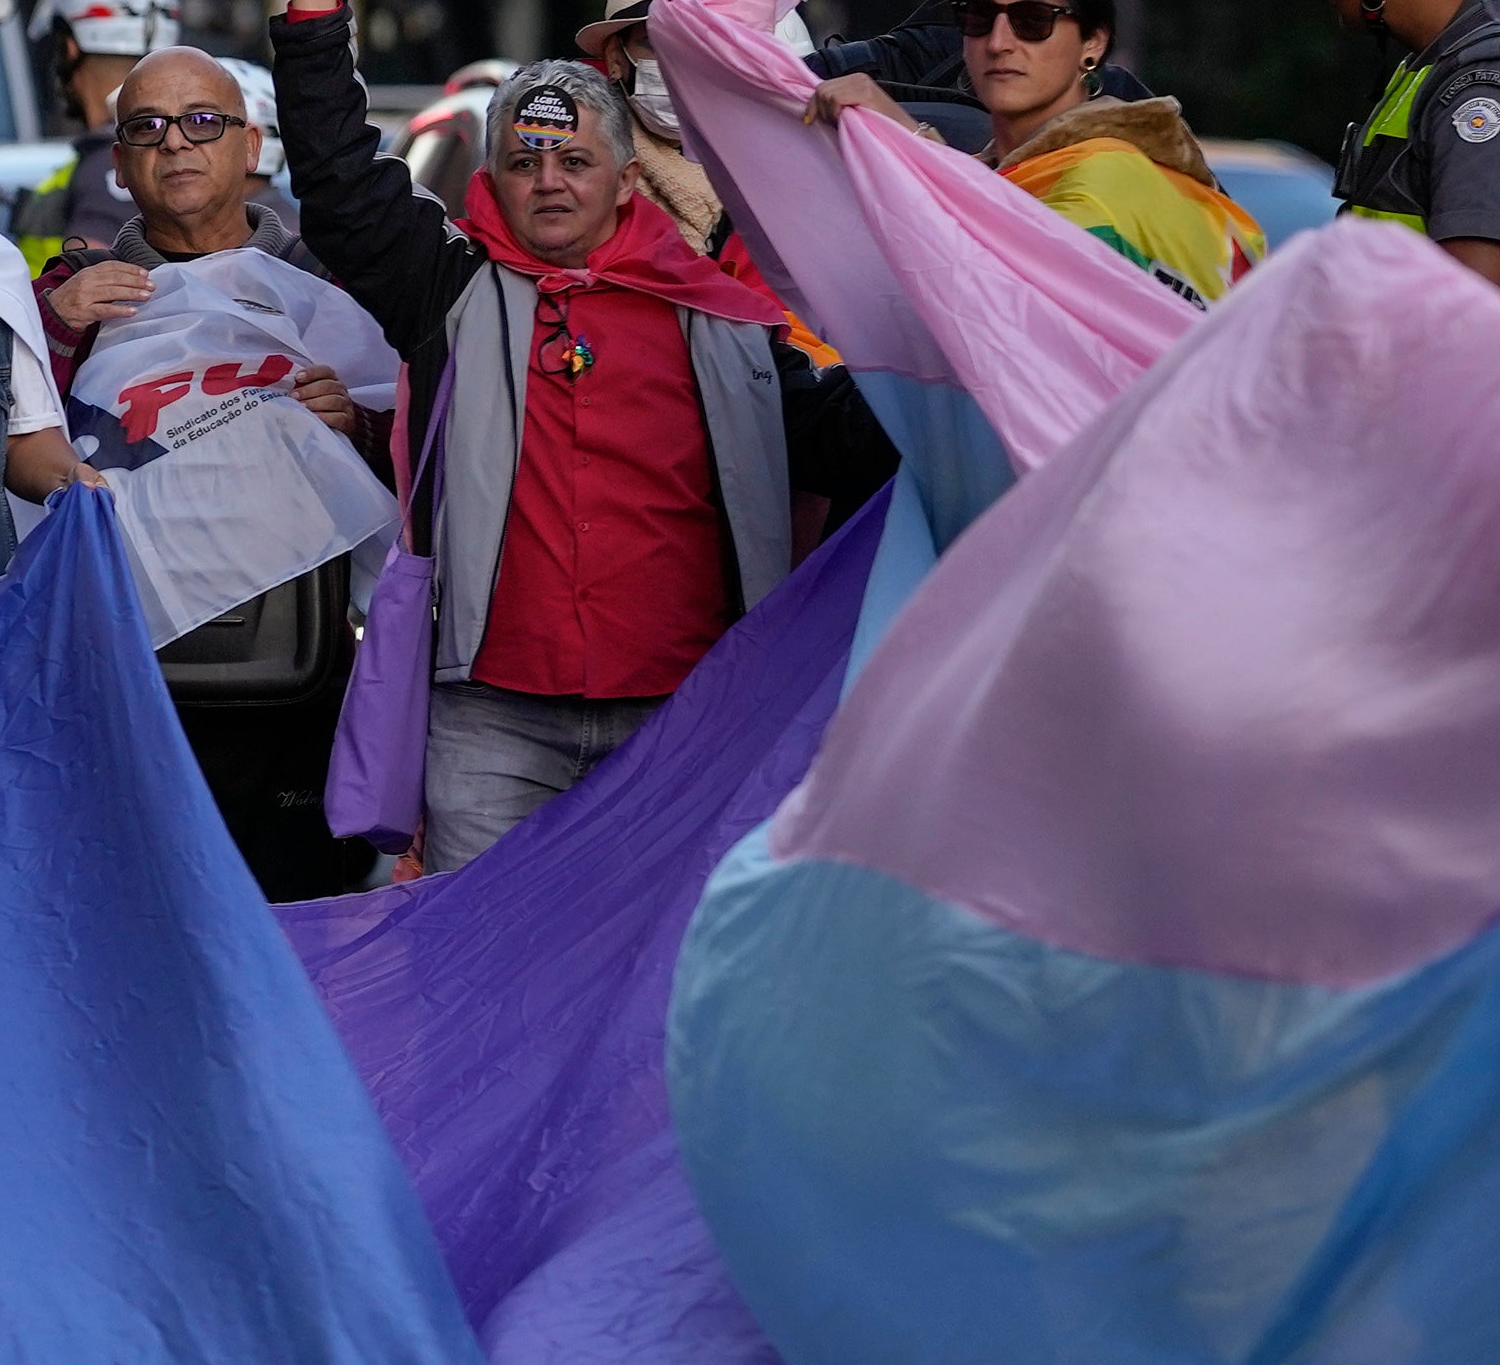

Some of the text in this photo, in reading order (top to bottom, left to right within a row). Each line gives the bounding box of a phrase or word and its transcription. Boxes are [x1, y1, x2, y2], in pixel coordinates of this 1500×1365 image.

[520, 109, 575, 122] BOLSONARO
[527, 103, 567, 114] CONTRA
[166, 407, 218, 439] Sindicato
[219, 395, 241, 411] dos
[172, 437, 188, 450] da
[188, 409, 243, 442] Educação
[244, 399, 259, 412] do
